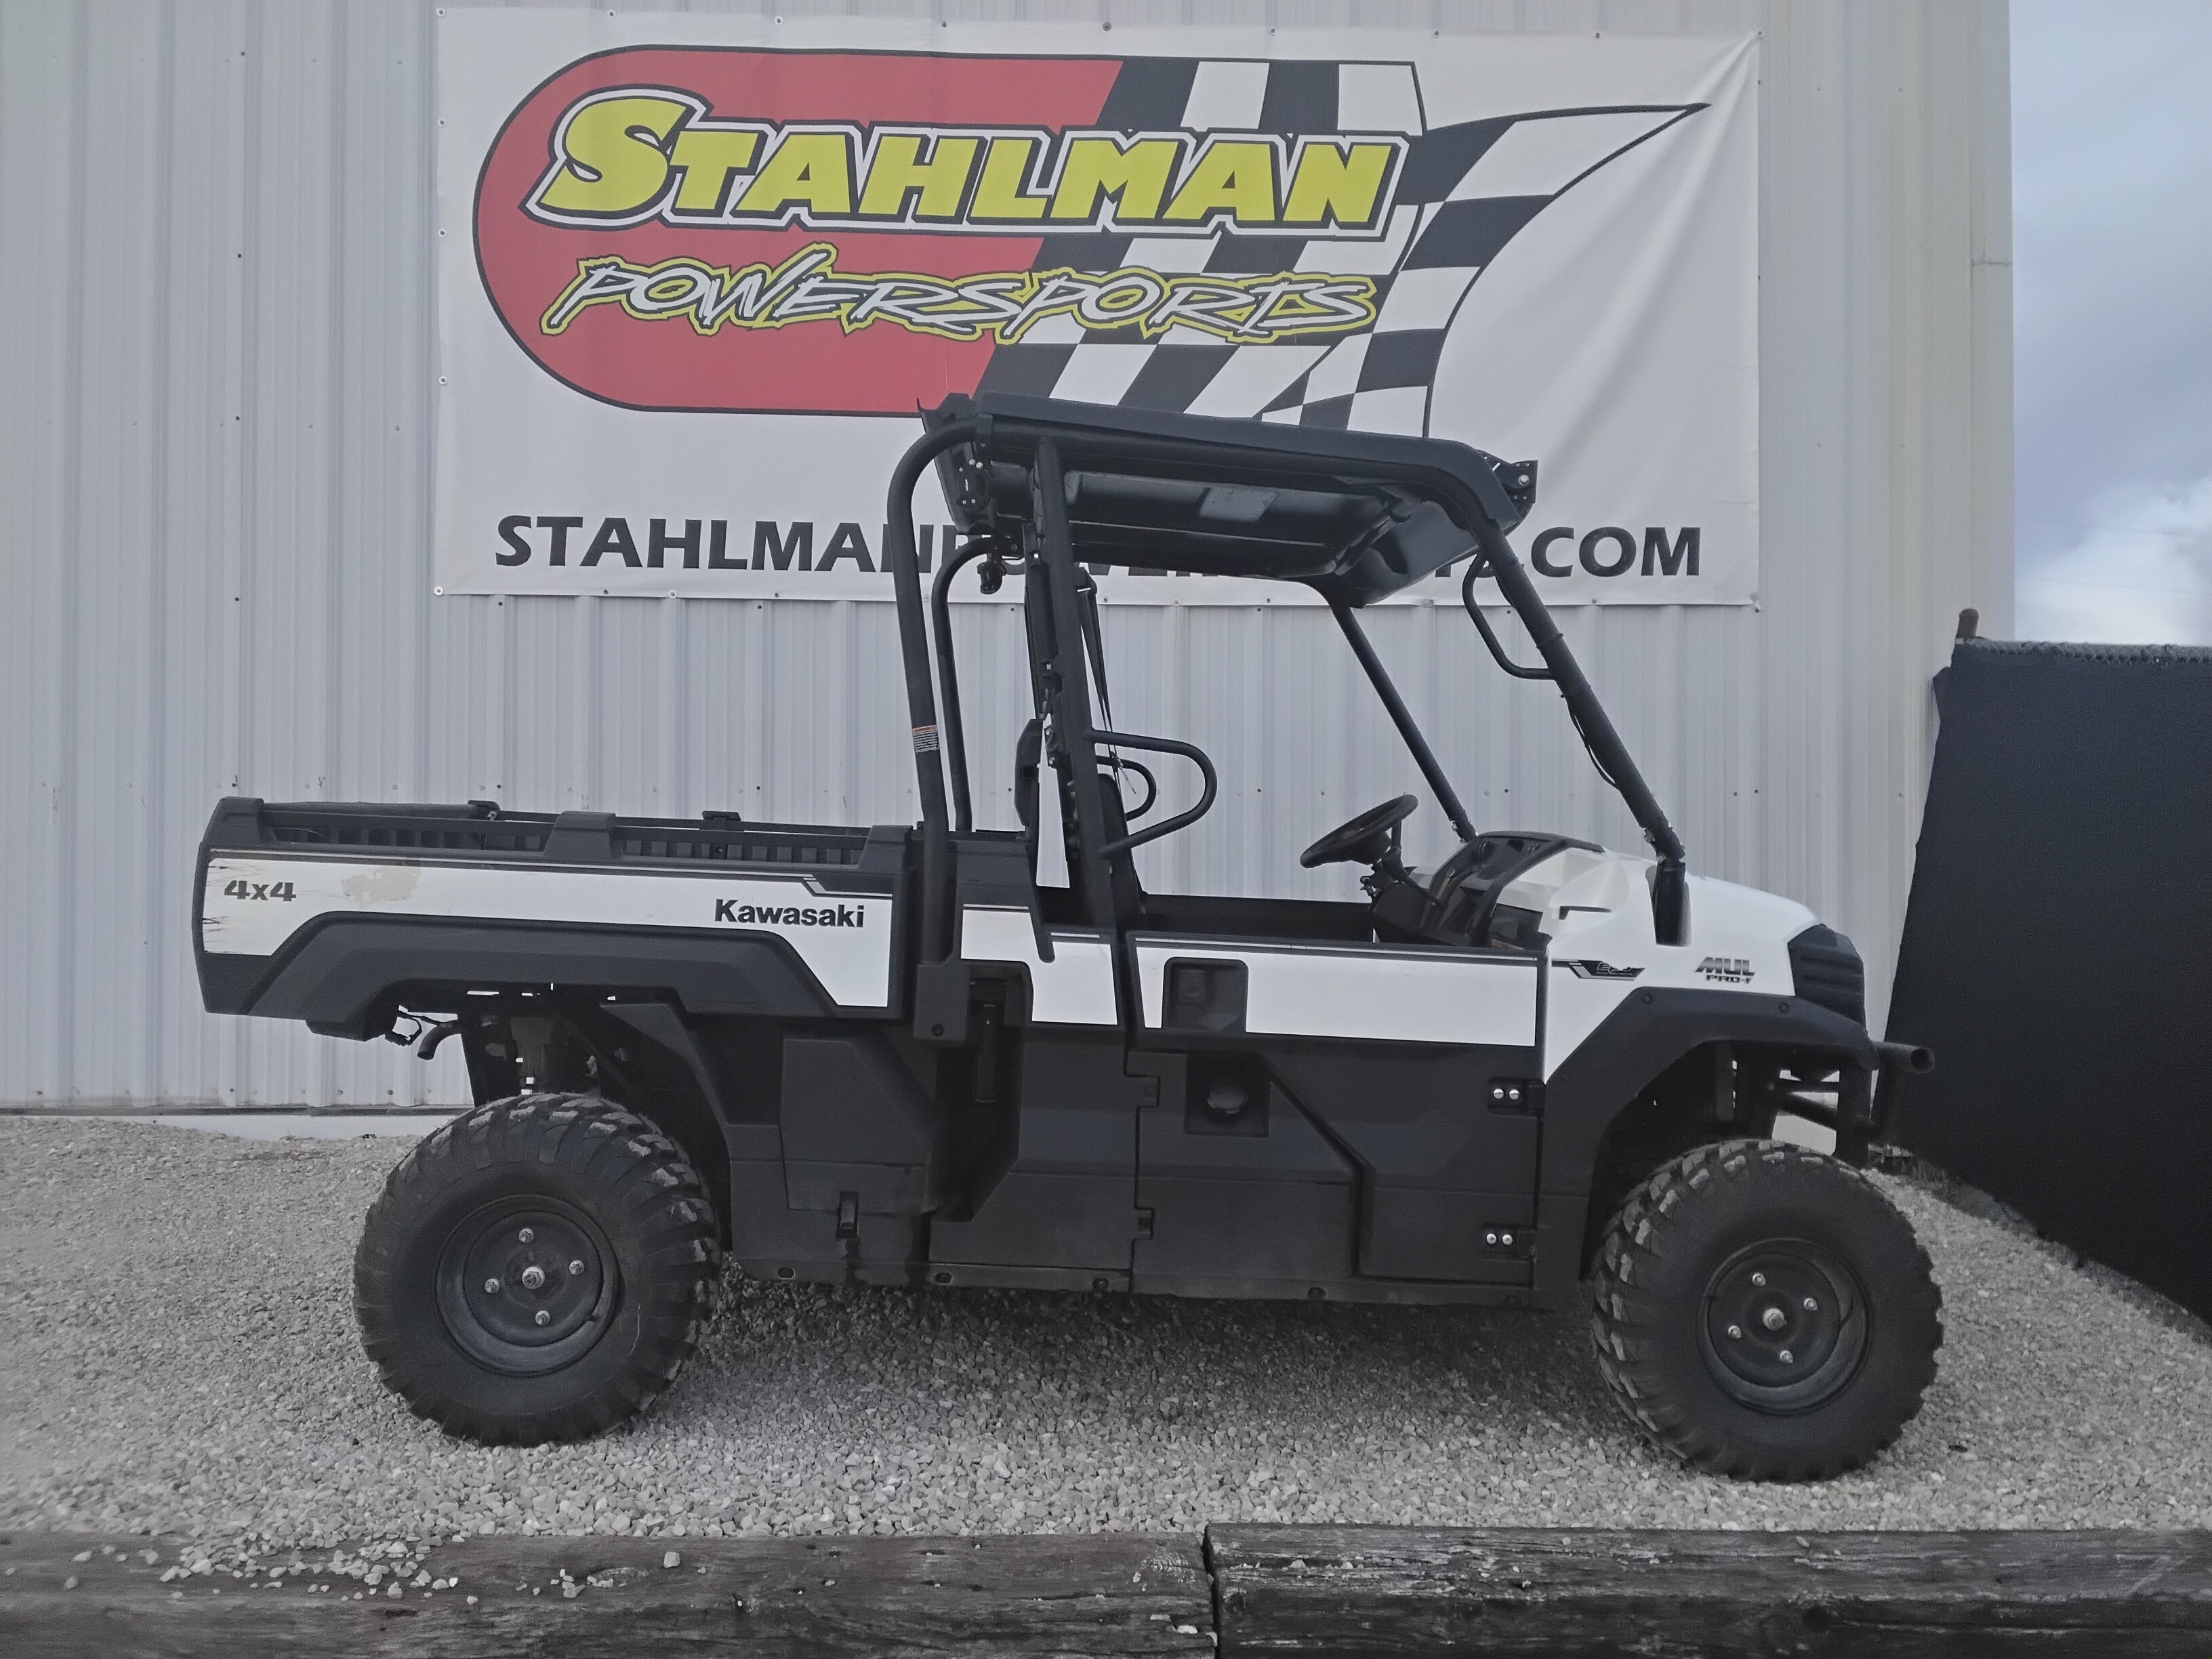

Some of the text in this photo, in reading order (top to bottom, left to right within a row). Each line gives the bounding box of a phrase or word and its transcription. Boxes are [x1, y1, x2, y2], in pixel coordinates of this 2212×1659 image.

[519, 83, 1408, 240] STAHLMAN
[541, 243, 1378, 344] POWERSPORTS
[223, 880, 297, 902] 4x4
[714, 899, 864, 928] Kawasaki
